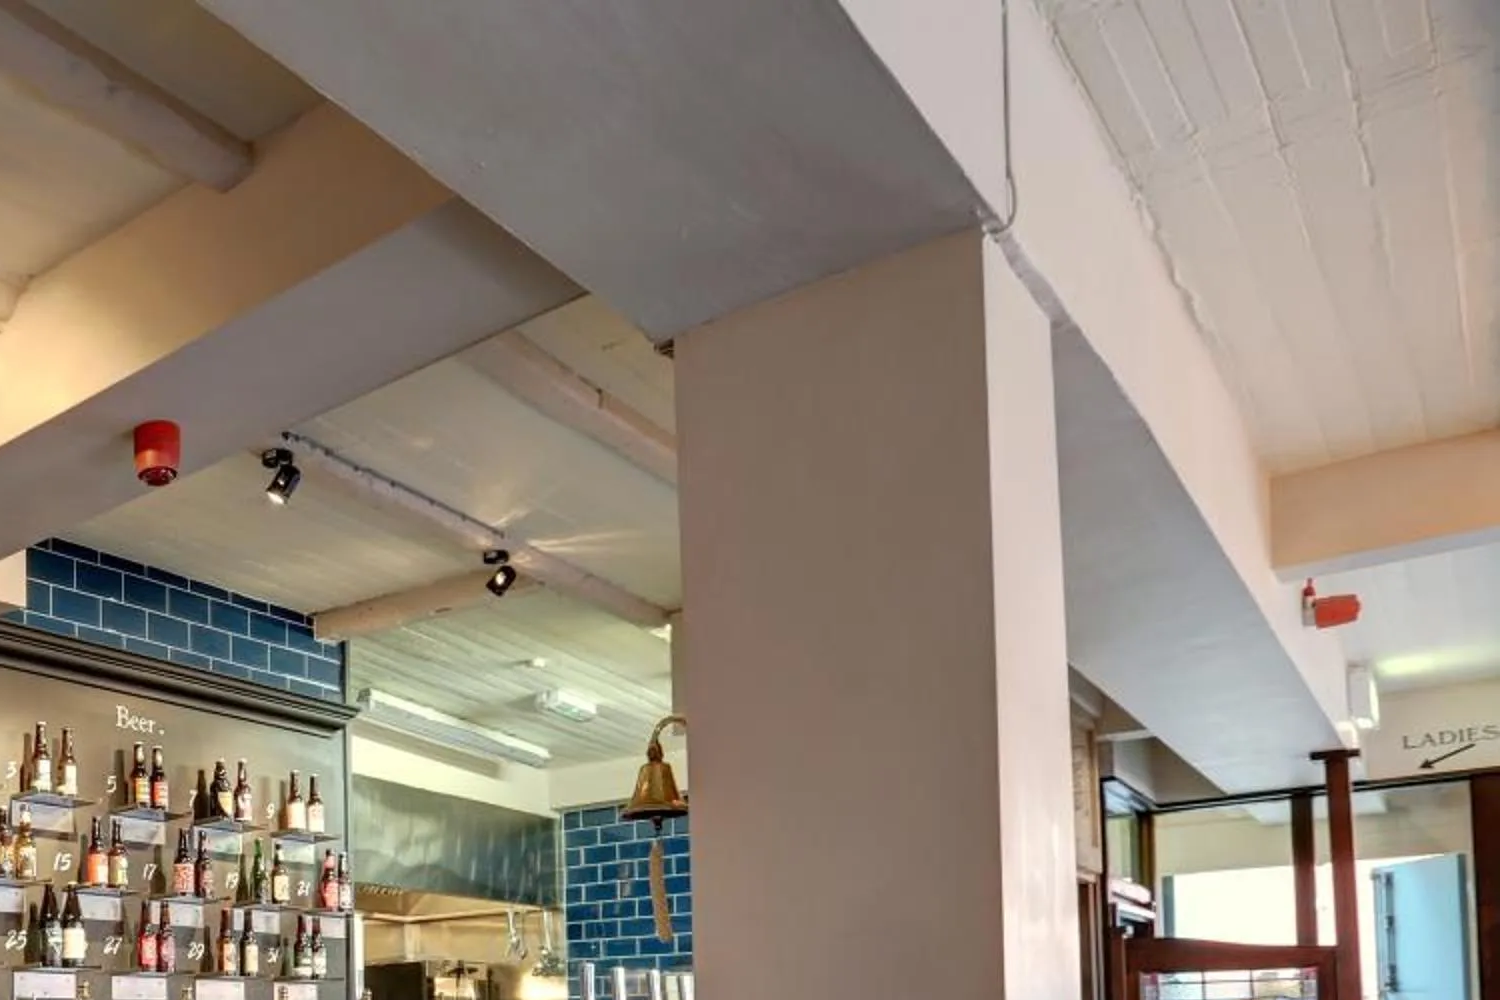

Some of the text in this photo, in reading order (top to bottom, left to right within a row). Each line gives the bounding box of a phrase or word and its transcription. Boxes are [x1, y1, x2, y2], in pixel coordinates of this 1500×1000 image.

[115, 704, 165, 735] Beer.
[1402, 724, 1500, 750] LADIES
[106, 776, 116, 793] 5
[53, 852, 73, 872] 15
[142, 864, 157, 881] 17
[5, 929, 28, 950] 25
